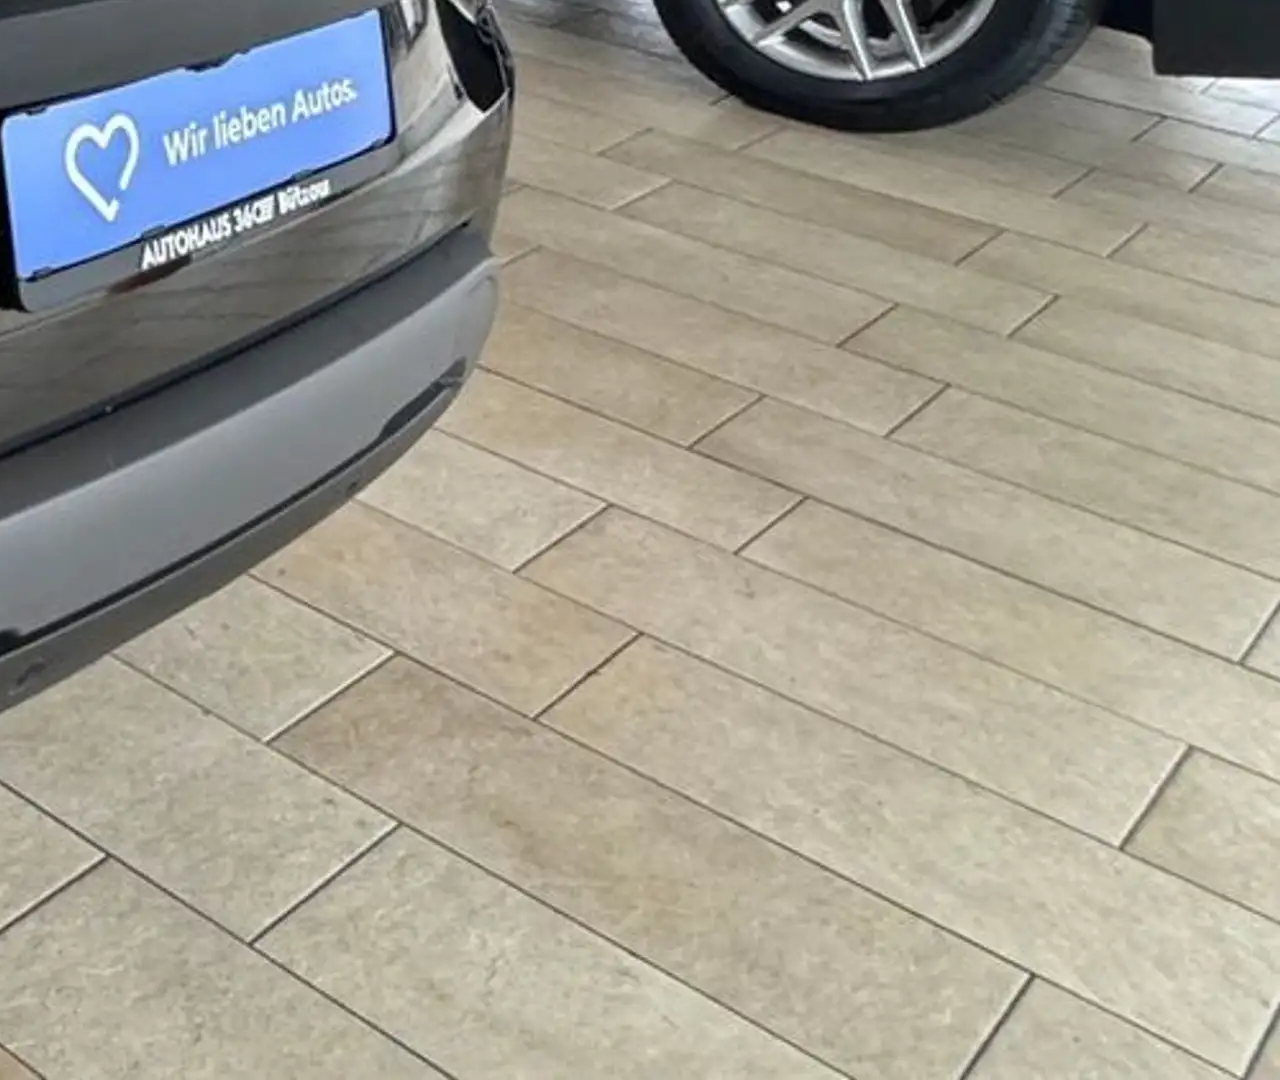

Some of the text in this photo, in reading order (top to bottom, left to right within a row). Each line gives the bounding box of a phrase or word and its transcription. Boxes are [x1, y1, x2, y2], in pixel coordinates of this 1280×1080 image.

[163, 78, 358, 166] Wir lieben Autos.
[142, 212, 232, 270] AUTOHAUS
